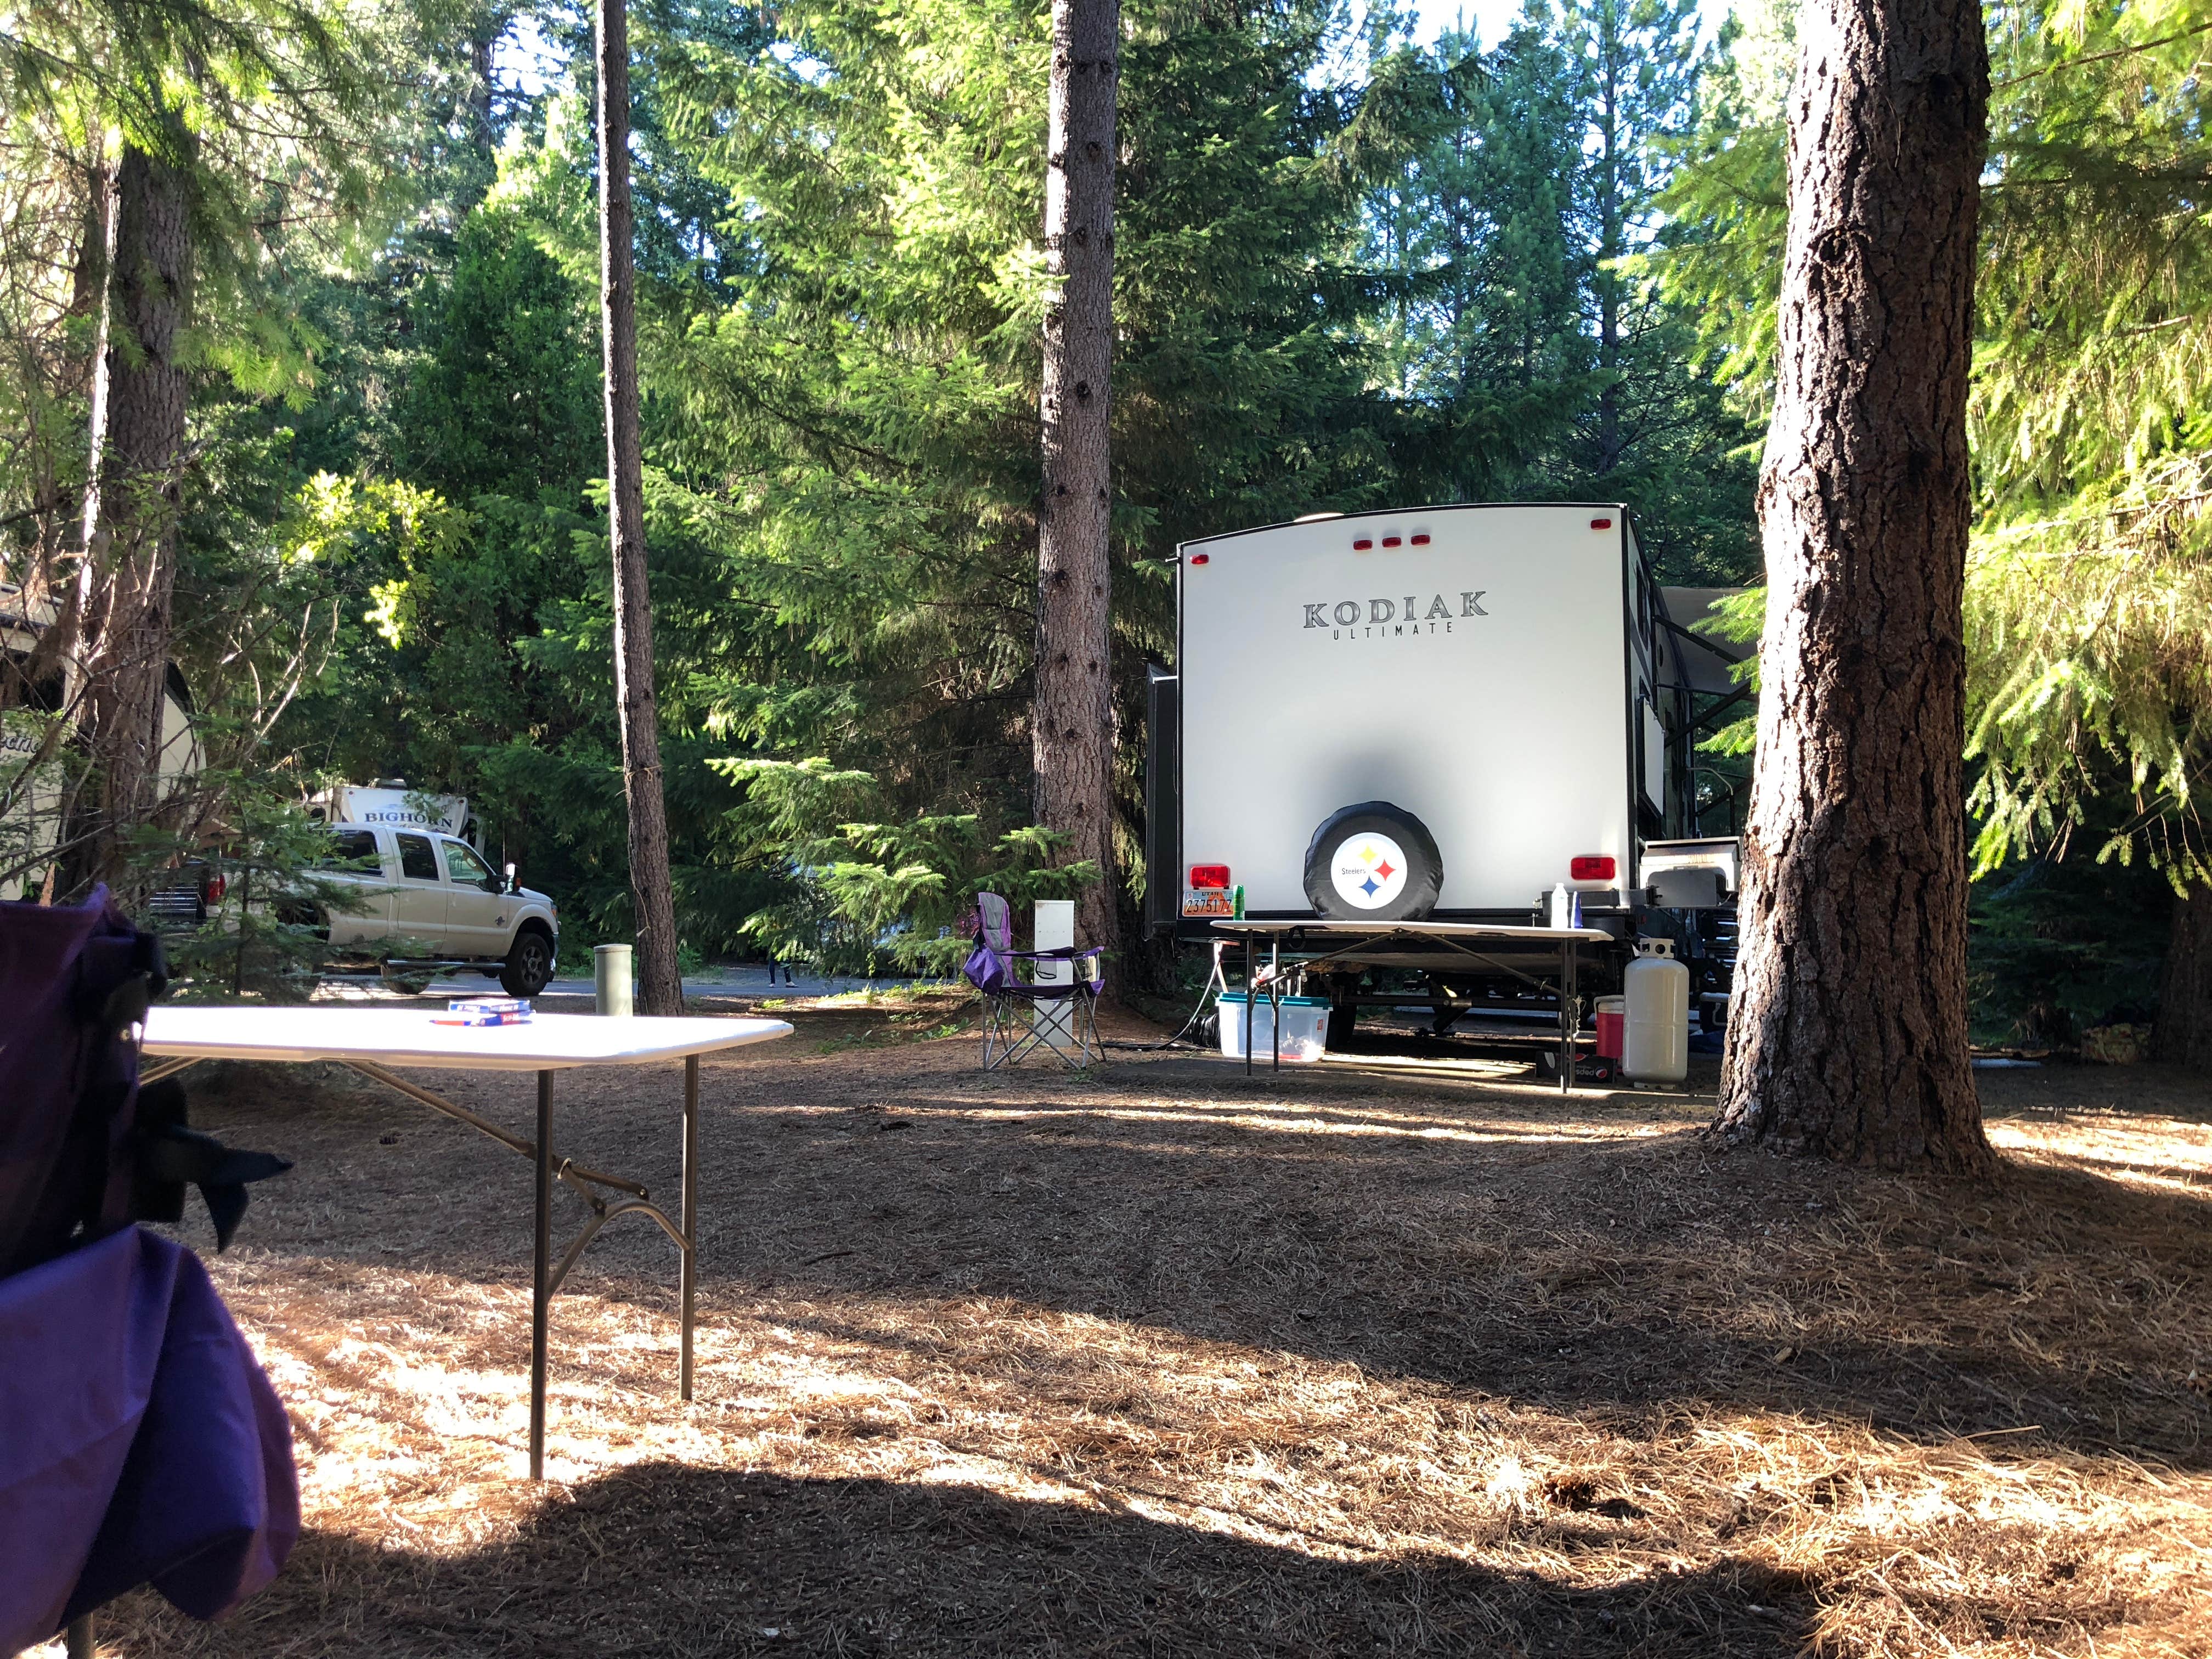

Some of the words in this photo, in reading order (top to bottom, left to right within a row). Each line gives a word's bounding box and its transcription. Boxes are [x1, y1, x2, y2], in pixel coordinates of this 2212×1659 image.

[1303, 591, 1488, 629] KODIAK
[1333, 622, 1453, 640] ULTIMATE
[1341, 867, 1366, 875] Steelers
